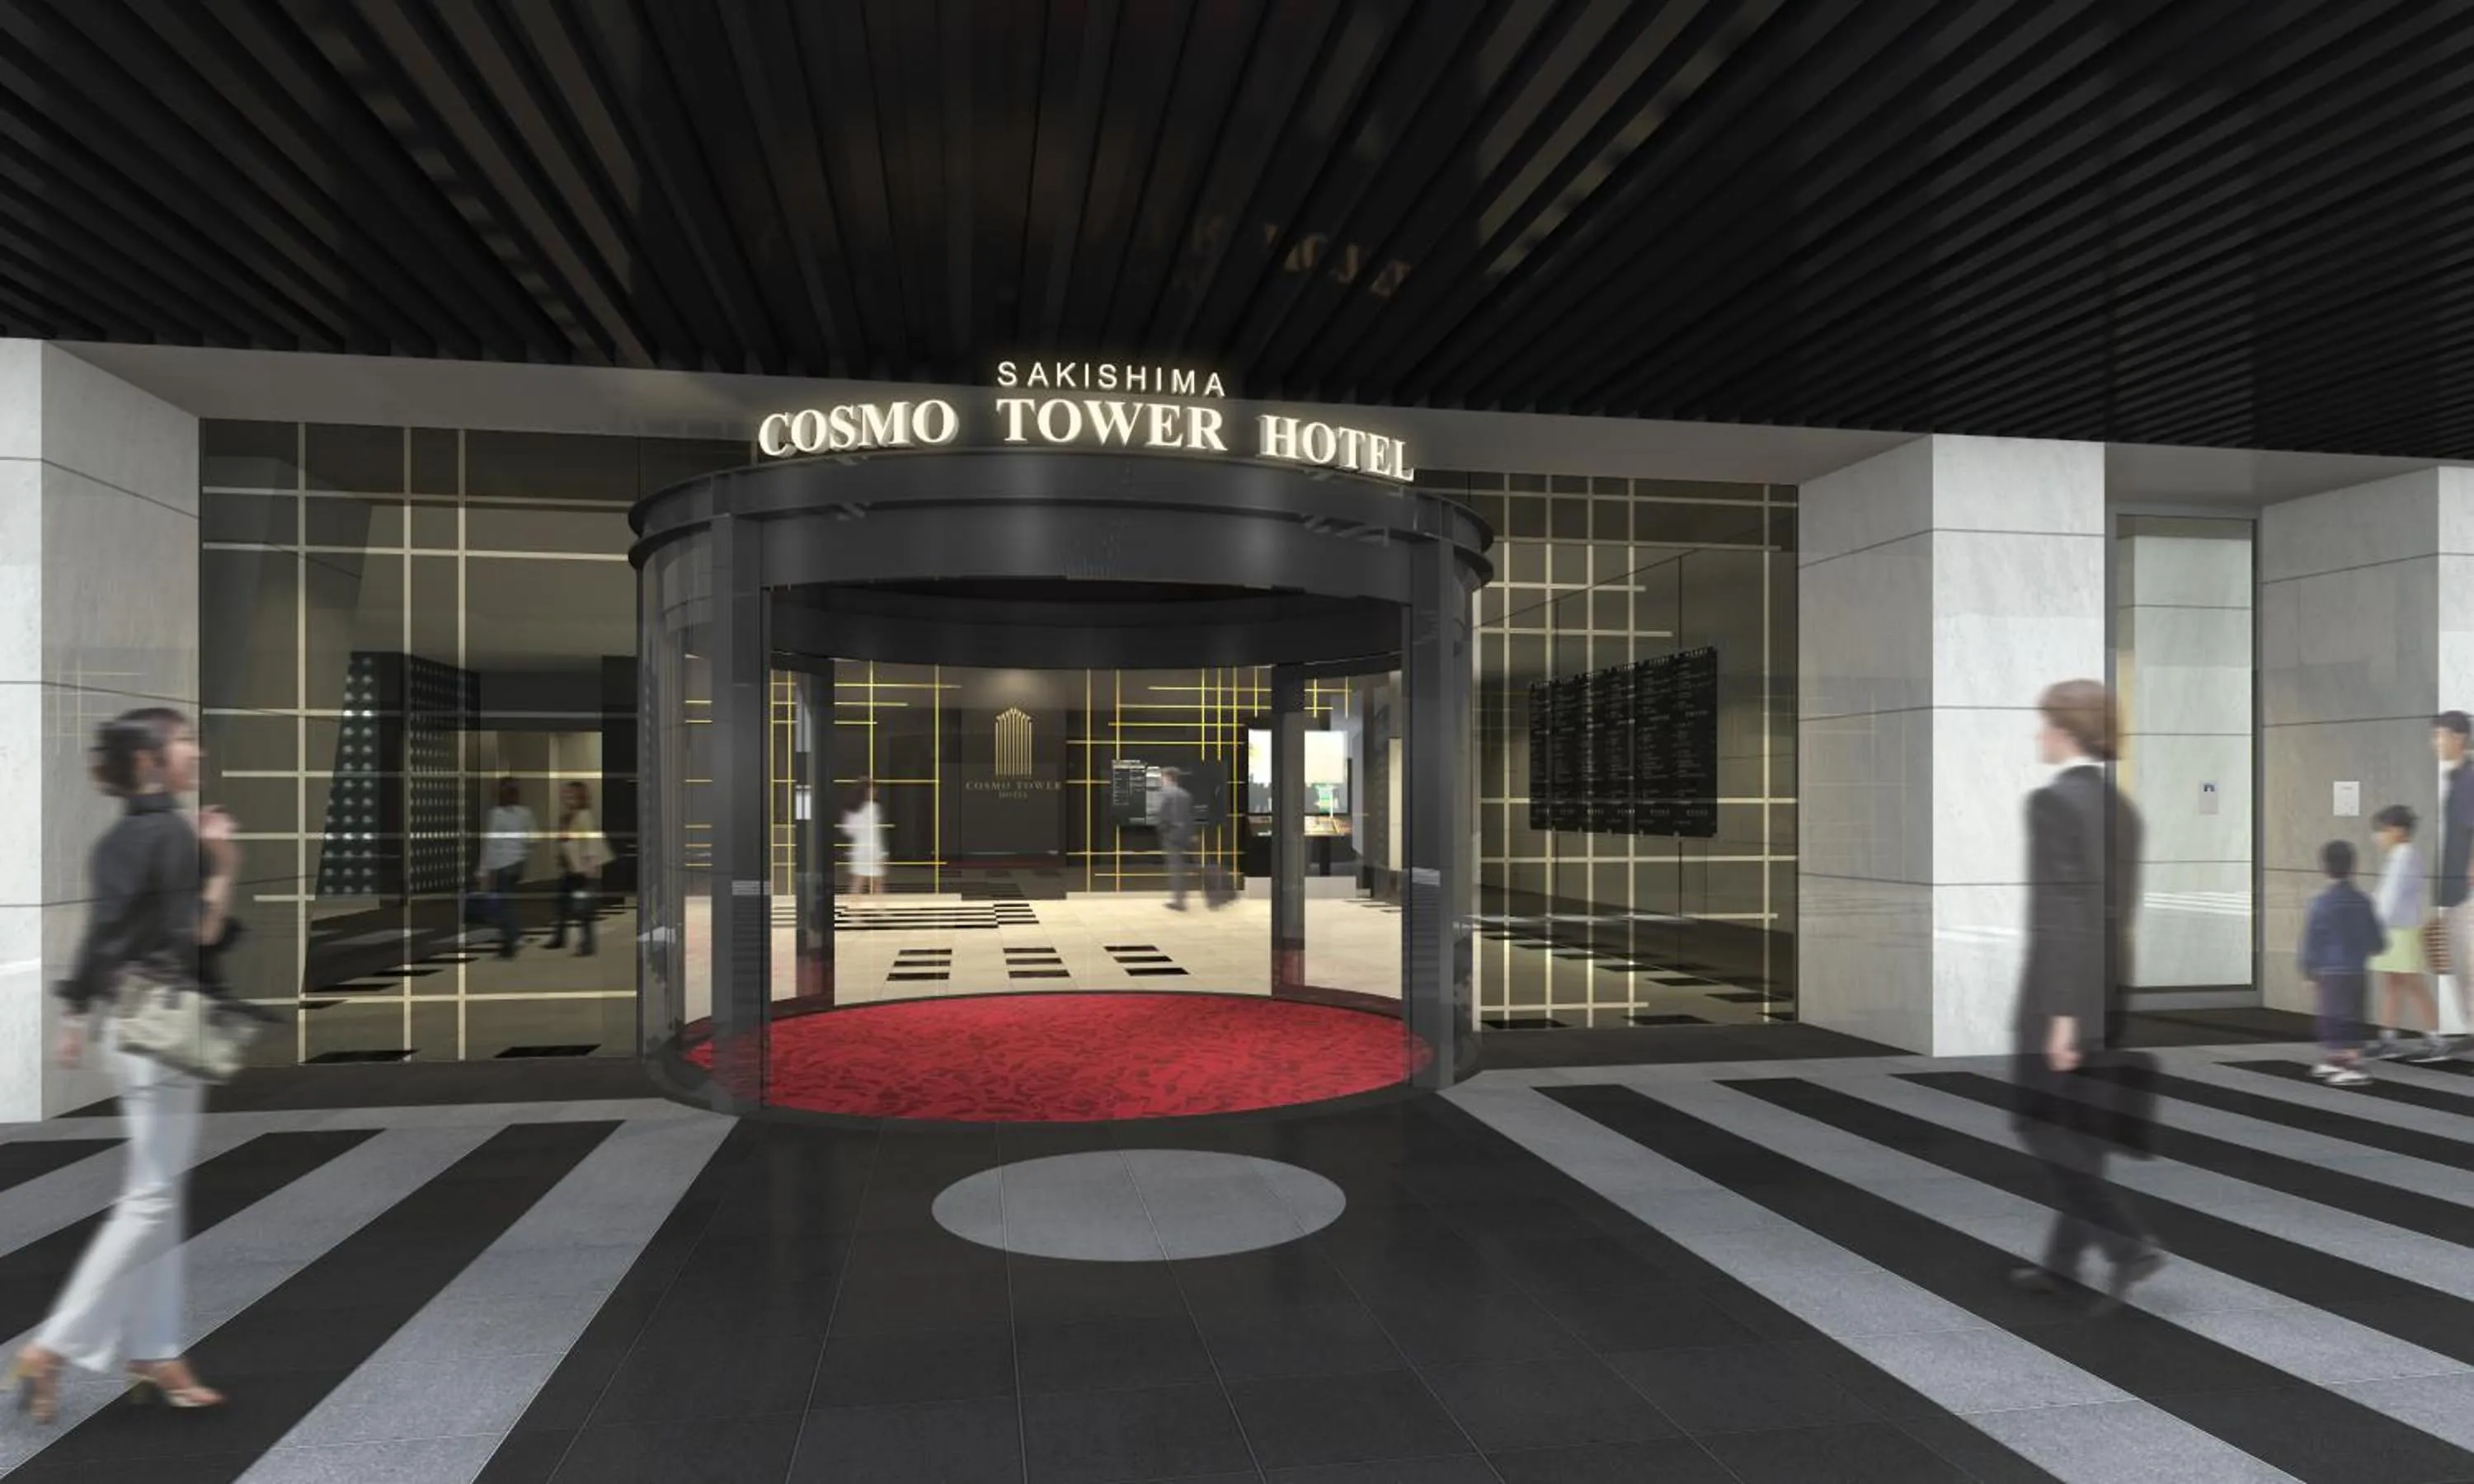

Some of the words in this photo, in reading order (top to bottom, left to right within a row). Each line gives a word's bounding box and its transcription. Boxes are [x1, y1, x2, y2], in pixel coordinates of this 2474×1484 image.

[996, 360, 1225, 397] SAKISHIMA
[758, 399, 959, 458] COSMO
[995, 398, 1228, 451] TOWER
[1256, 414, 1414, 481] HOTEL
[965, 780, 1011, 791] COSMO
